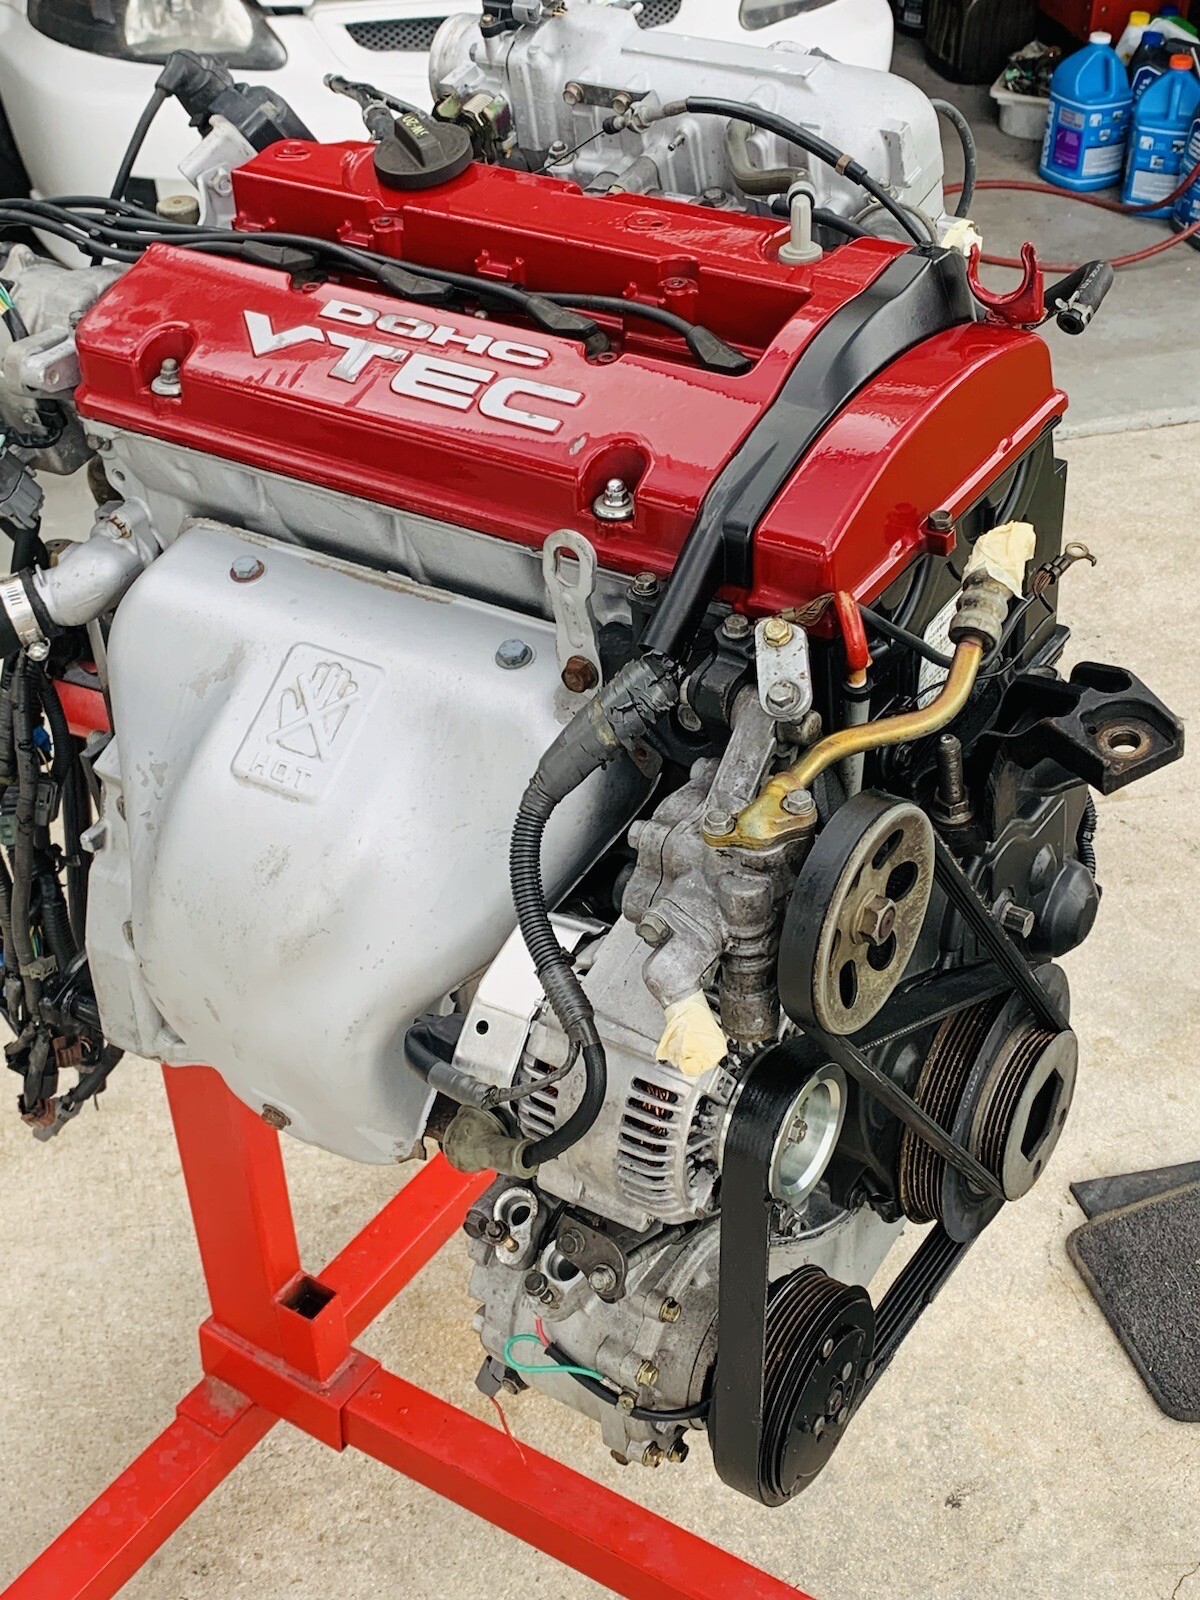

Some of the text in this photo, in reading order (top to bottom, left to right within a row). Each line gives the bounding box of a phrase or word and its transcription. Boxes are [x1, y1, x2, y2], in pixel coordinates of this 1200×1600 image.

[319, 298, 551, 368] DOHC
[243, 309, 585, 435] VTEC
[249, 751, 312, 788] HOT
